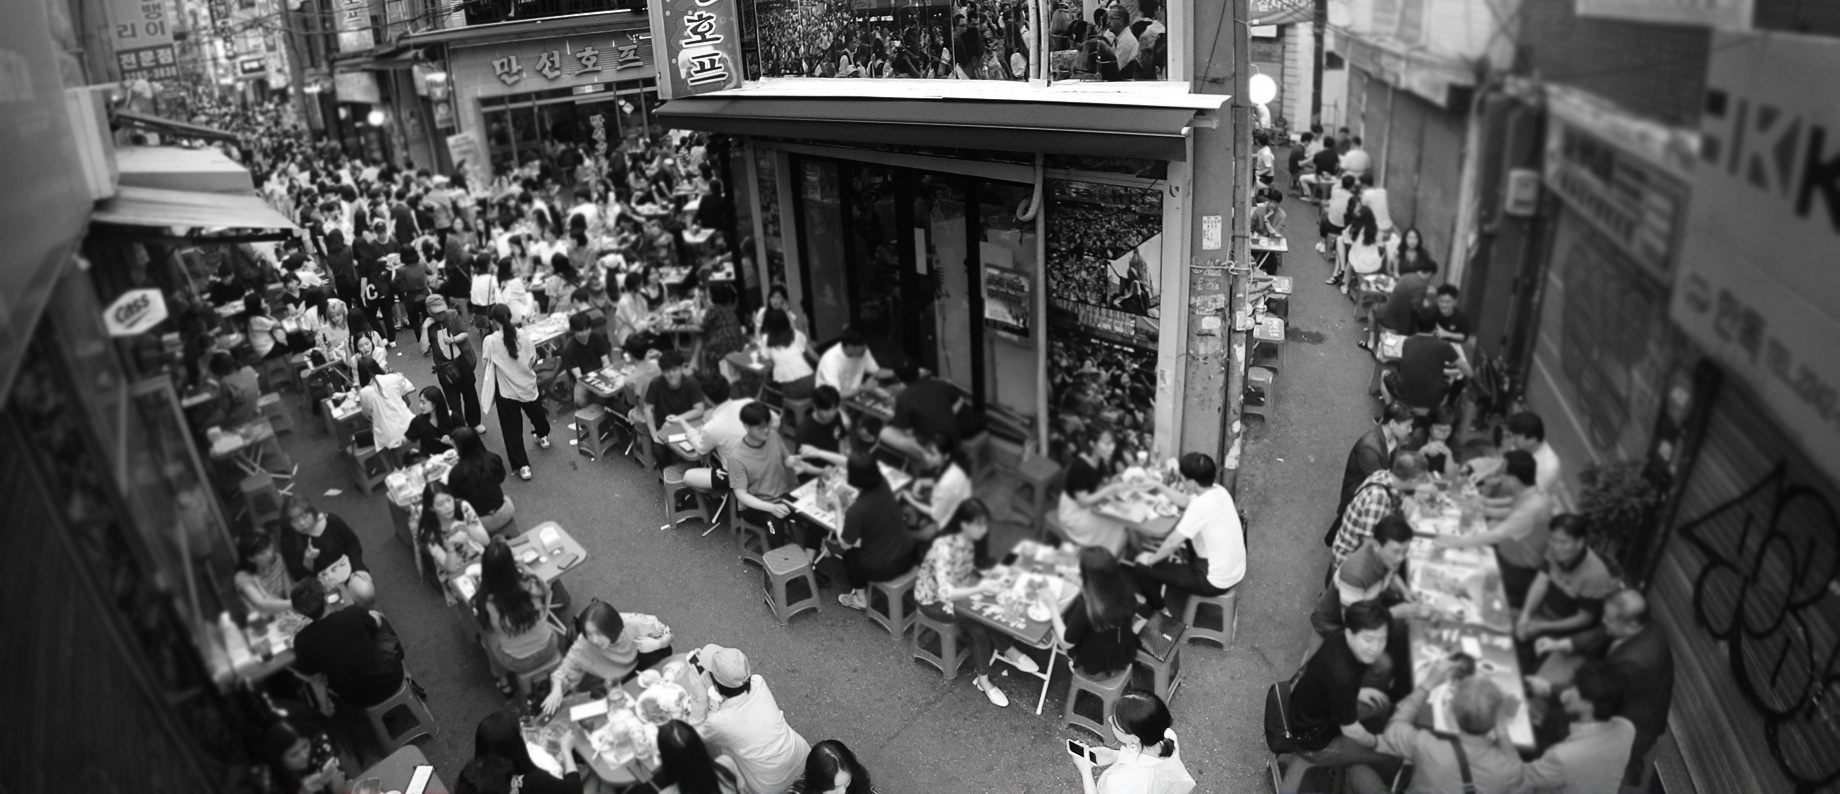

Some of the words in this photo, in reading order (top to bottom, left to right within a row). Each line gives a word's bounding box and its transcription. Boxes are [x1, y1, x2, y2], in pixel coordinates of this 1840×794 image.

[141, 0, 166, 37] 뱅이
[119, 48, 174, 70] 전문점
[679, 0, 729, 86] 호프
[491, 44, 644, 85] 만선호프
